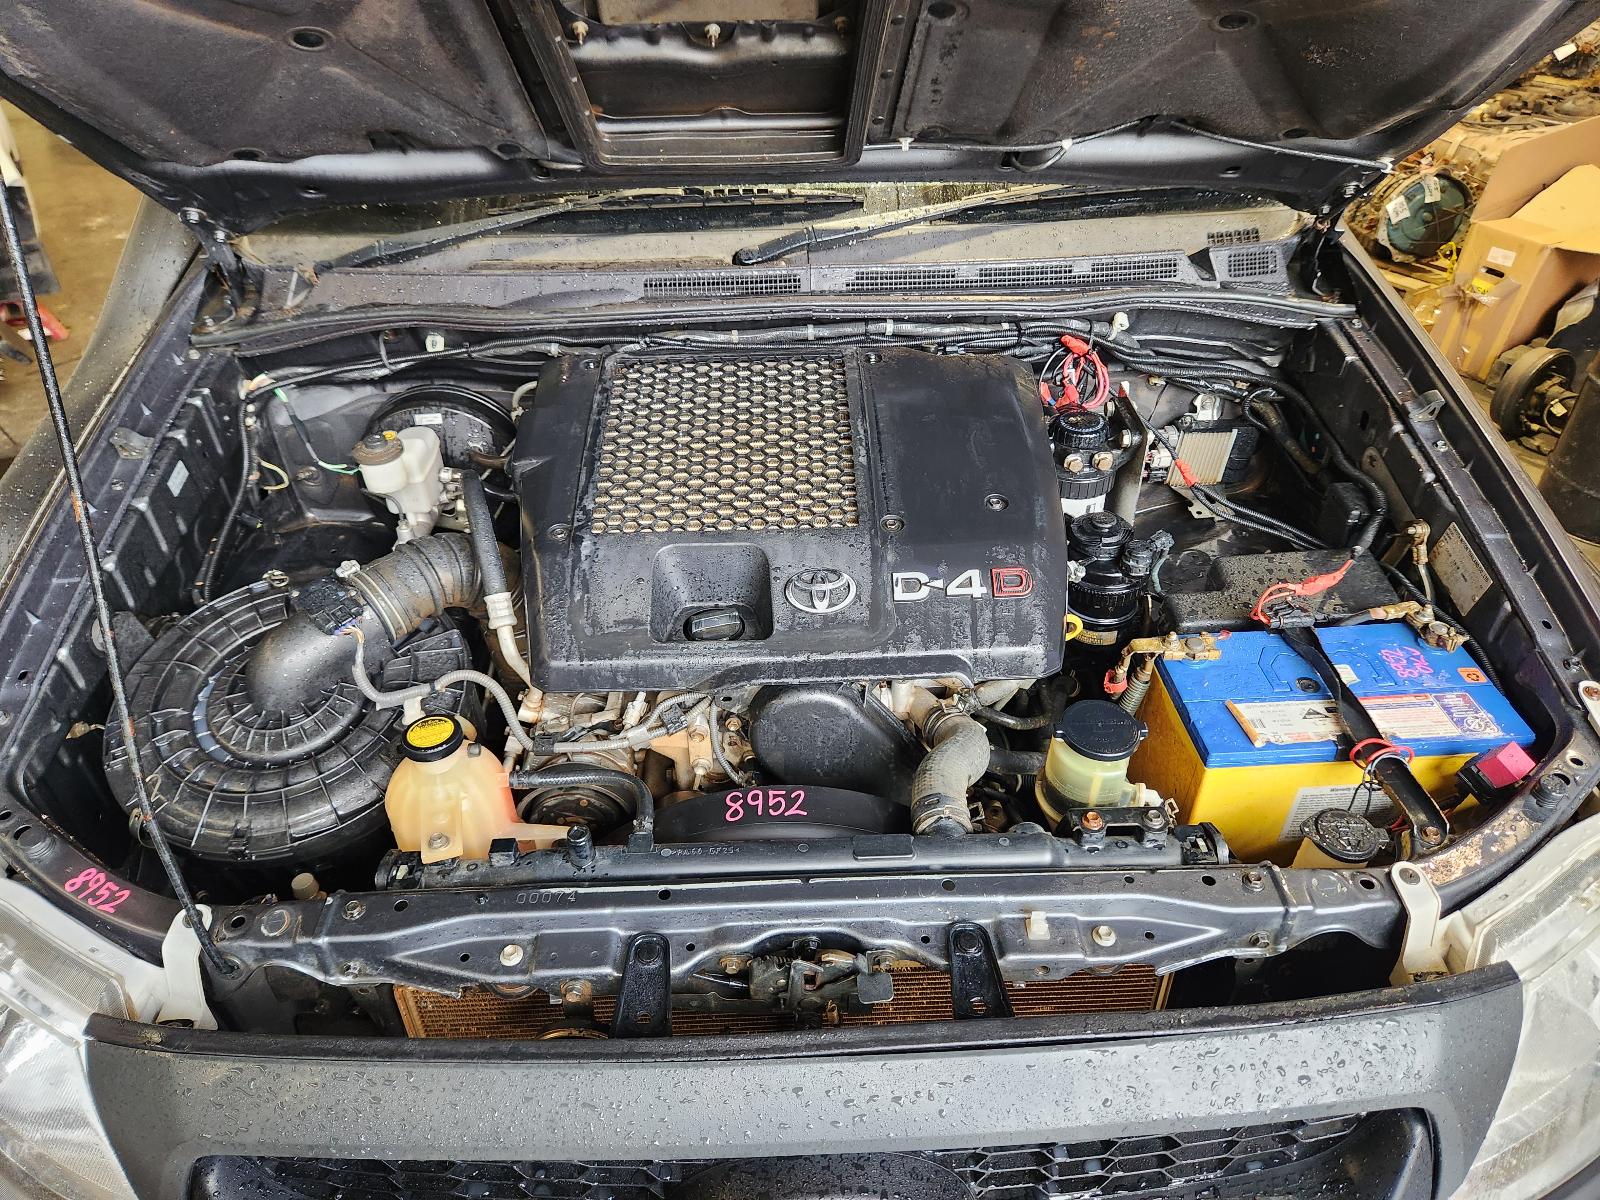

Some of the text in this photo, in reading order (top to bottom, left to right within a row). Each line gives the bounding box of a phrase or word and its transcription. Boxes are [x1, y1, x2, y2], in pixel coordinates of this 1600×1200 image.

[892, 568, 1033, 601] D-4D
[725, 790, 807, 822] 8952
[64, 867, 130, 914] 8952
[516, 890, 576, 904] 00074
